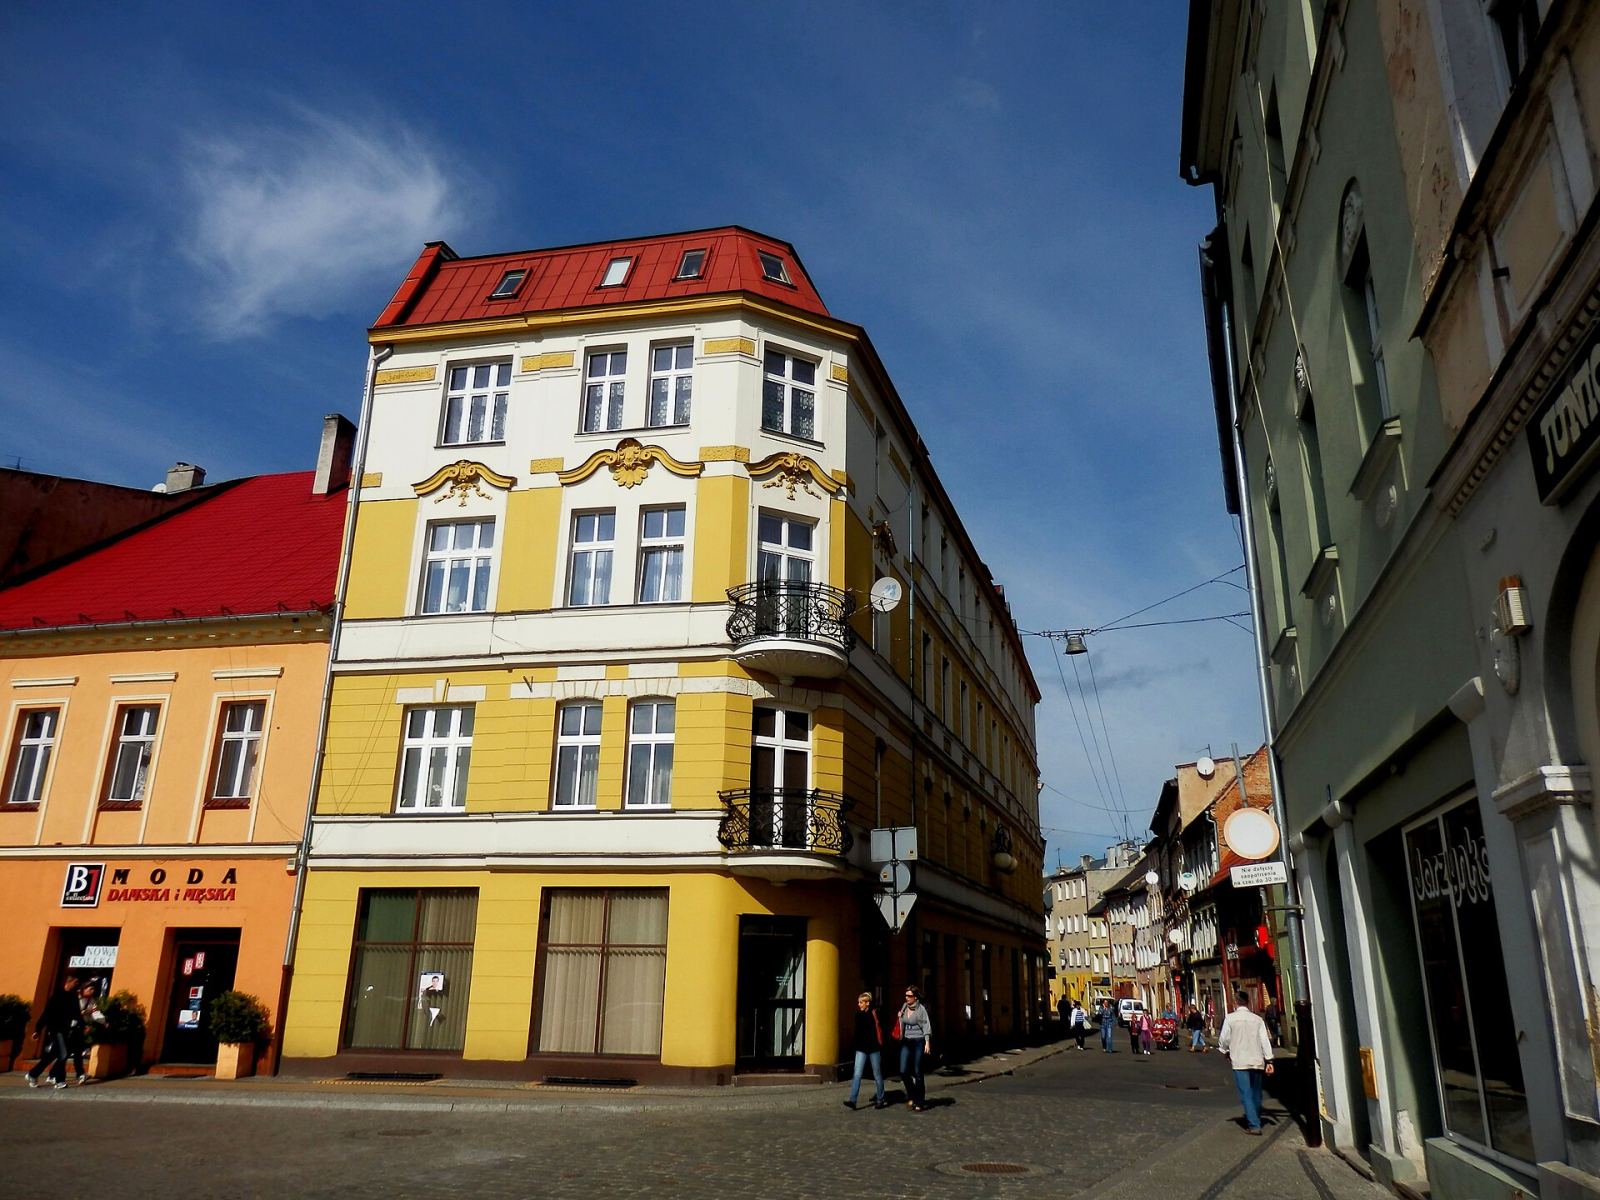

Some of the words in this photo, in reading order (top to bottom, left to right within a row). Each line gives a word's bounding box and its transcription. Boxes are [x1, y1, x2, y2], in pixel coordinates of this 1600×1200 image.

[69, 866, 100, 898] B1
[112, 868, 237, 885] MODA
[107, 888, 170, 901] DAMSKA
[174, 888, 180, 900] i
[183, 888, 236, 904] MĘSKA
